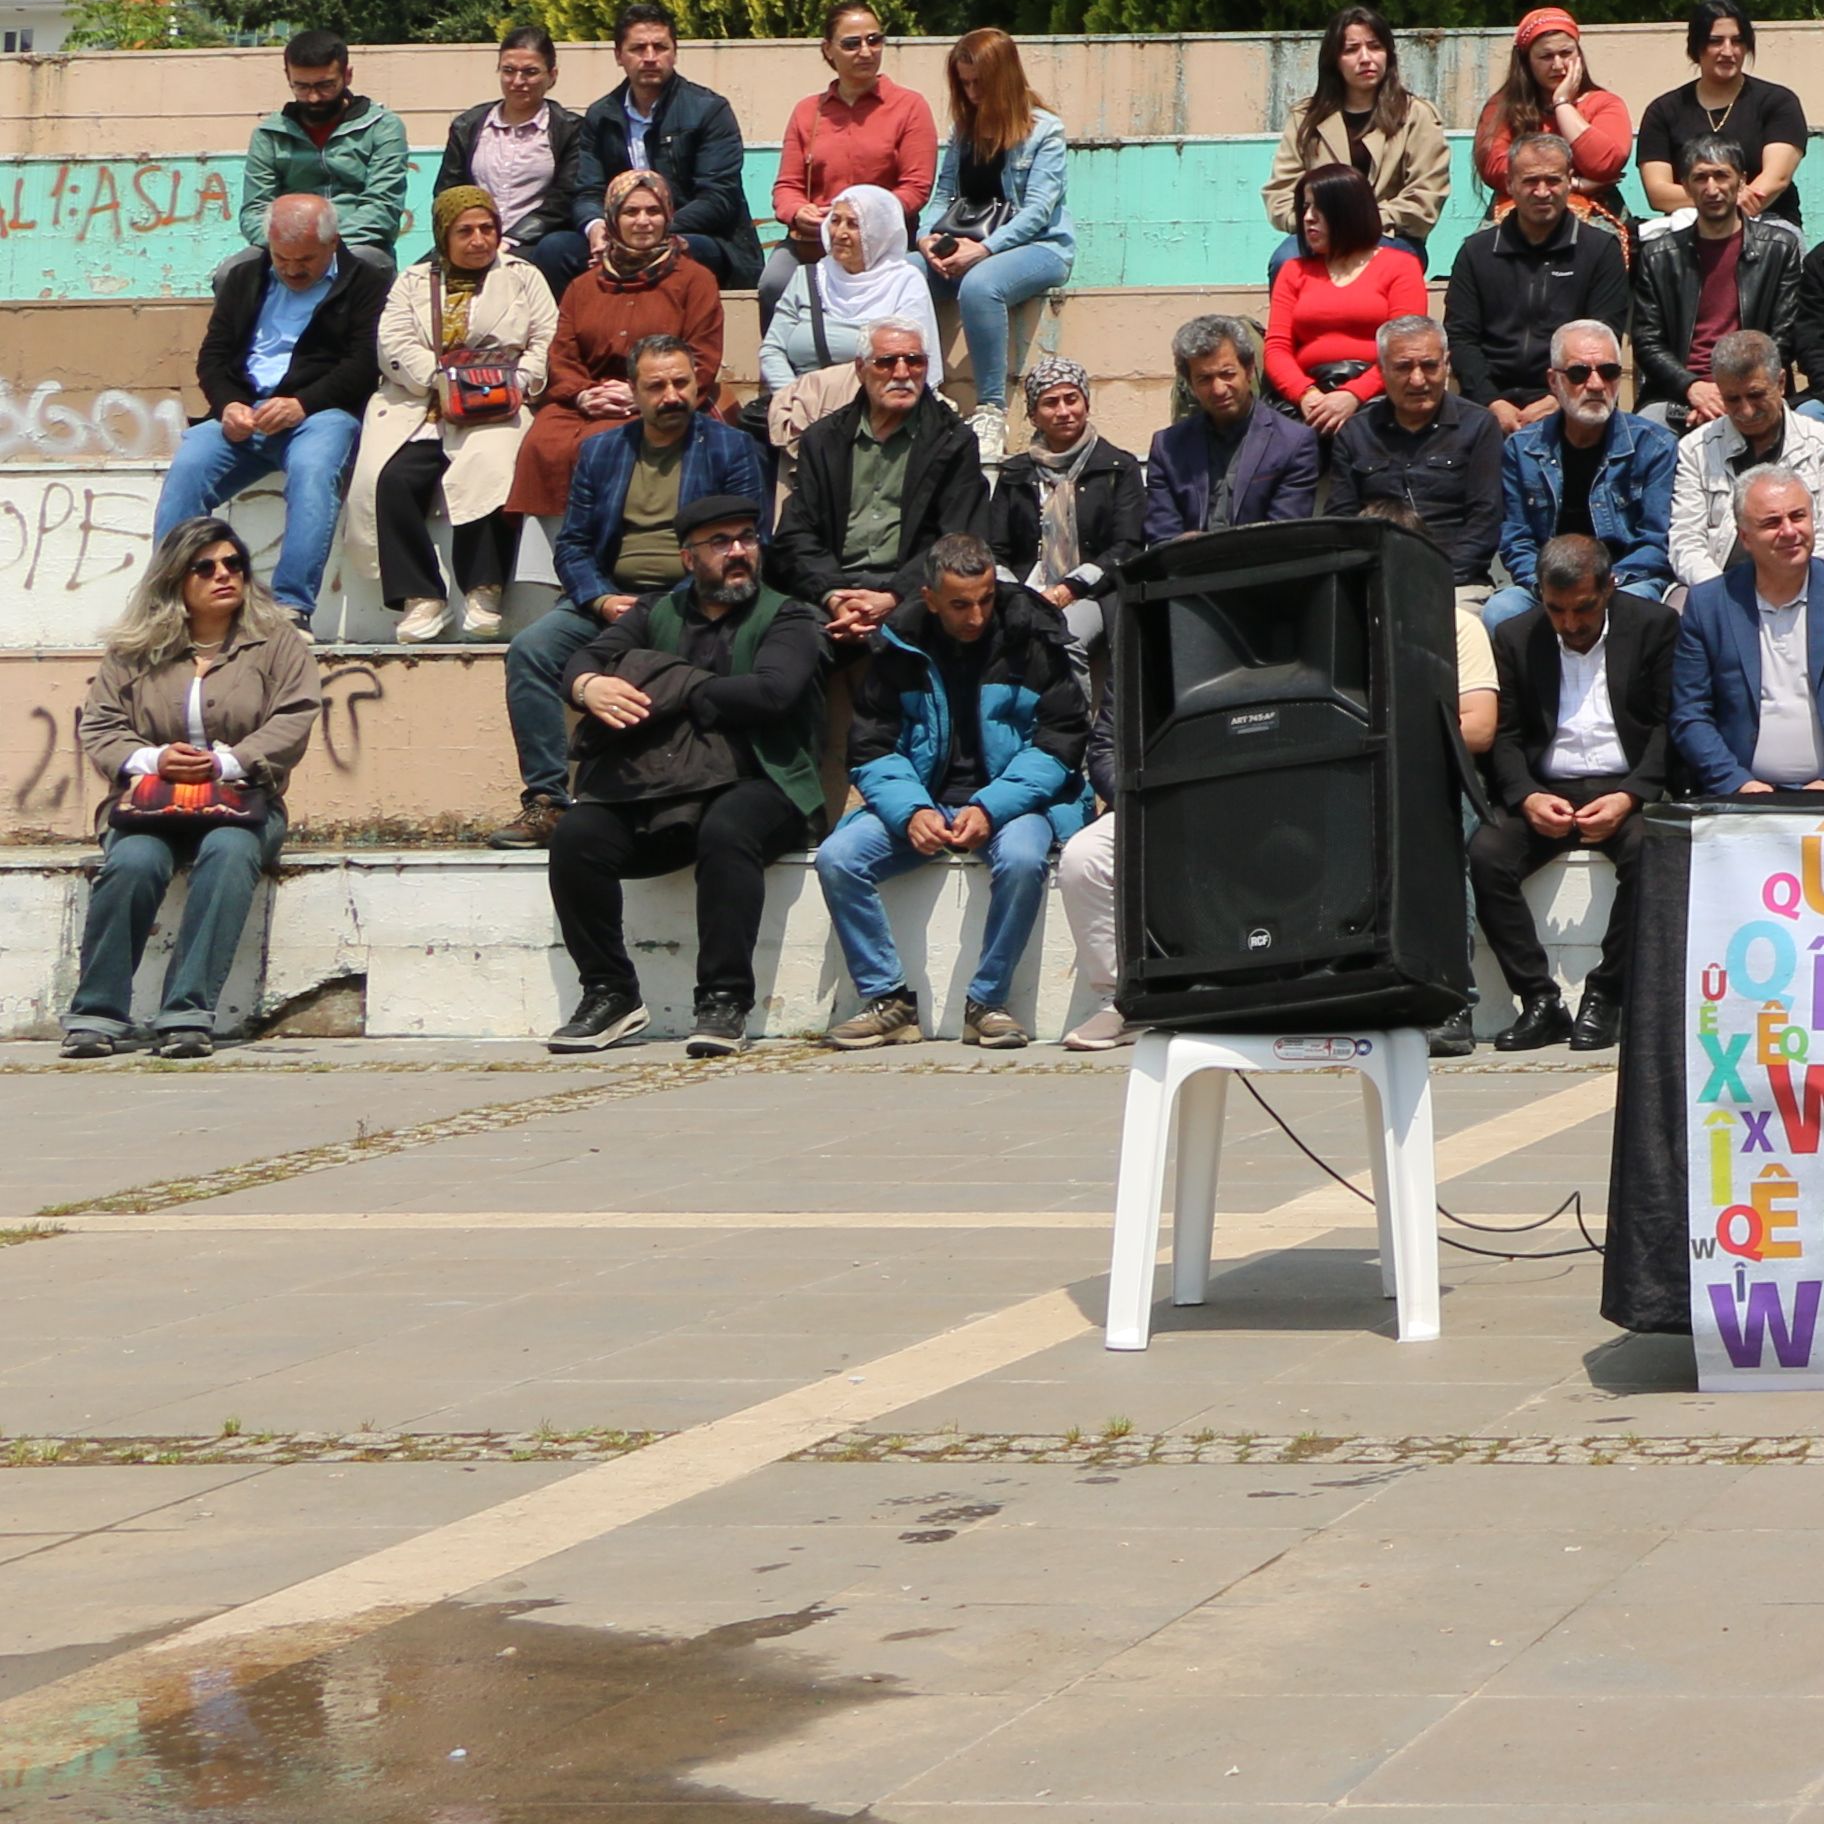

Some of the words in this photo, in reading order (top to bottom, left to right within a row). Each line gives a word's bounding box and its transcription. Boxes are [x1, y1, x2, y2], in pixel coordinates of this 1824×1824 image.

[1762, 872, 1800, 920] Q
[1725, 920, 1796, 1012] Q
[1696, 1034, 1753, 1103] X
[1779, 1026, 1808, 1064] Q
[1738, 1111, 1775, 1153] X
[1691, 1238, 1716, 1259] W
[1716, 1204, 1763, 1262] Q
[1707, 1280, 1823, 1368] W
